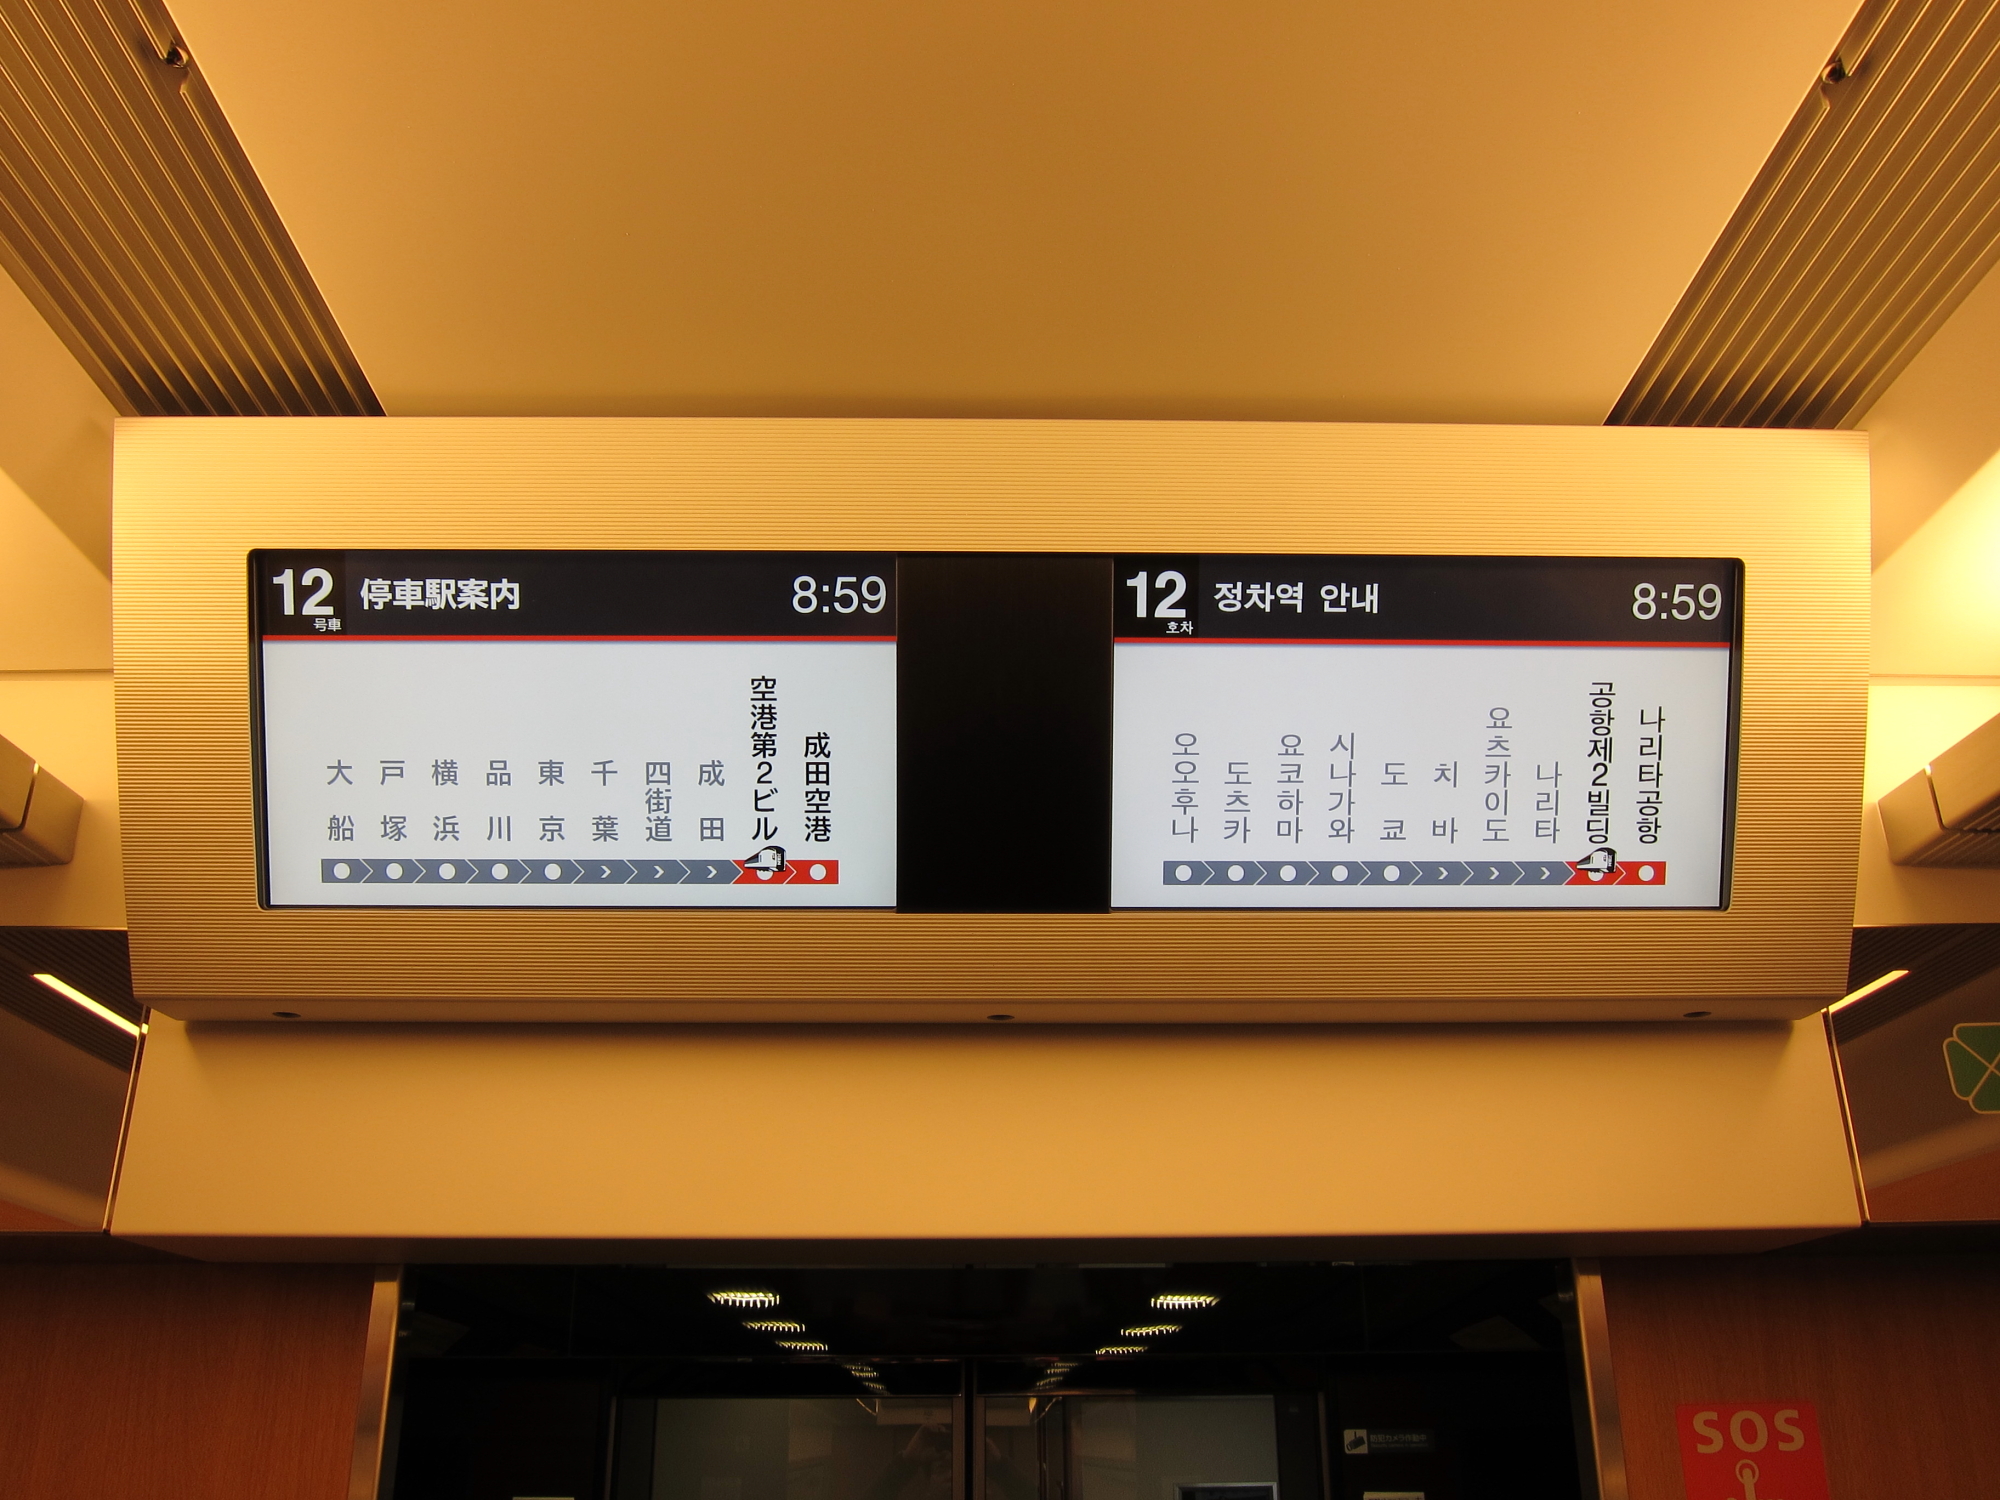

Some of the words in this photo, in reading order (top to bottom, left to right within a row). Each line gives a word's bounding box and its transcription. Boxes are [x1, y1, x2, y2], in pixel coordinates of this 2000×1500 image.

[272, 567, 334, 616] 12
[313, 617, 342, 632] 号車
[359, 577, 520, 610] 停車駅案内
[792, 575, 887, 614] 8:59
[1126, 570, 1187, 619] 12
[1165, 620, 1194, 635] 호차
[1213, 581, 1304, 614] 정차역
[1320, 582, 1379, 614] 안내
[1632, 582, 1722, 621] 8:59
[749, 674, 779, 841] 空港第2ビル
[803, 731, 832, 843] 成田空港
[1171, 732, 1200, 844] 오오후나
[1276, 734, 1305, 844] 요코하마
[1328, 732, 1357, 844] 시나가와
[1482, 707, 1513, 842] 요츠카이도
[1586, 681, 1617, 845] 공항제2빌딩
[1635, 705, 1666, 845] 나리타공항
[326, 759, 355, 842] 大船
[379, 760, 408, 842] 戸塚
[431, 759, 460, 842] 横浜
[486, 759, 512, 842] 品川
[537, 759, 566, 842] 東京
[590, 759, 619, 843] 千葉
[644, 761, 673, 842] 四街道
[697, 759, 726, 842] 成田
[1223, 761, 1252, 844] 도츠카
[1379, 762, 1409, 841] 도쿄
[1432, 760, 1459, 845] 치바
[1535, 761, 1563, 844] 나리타
[1693, 1409, 1805, 1454] SOS
